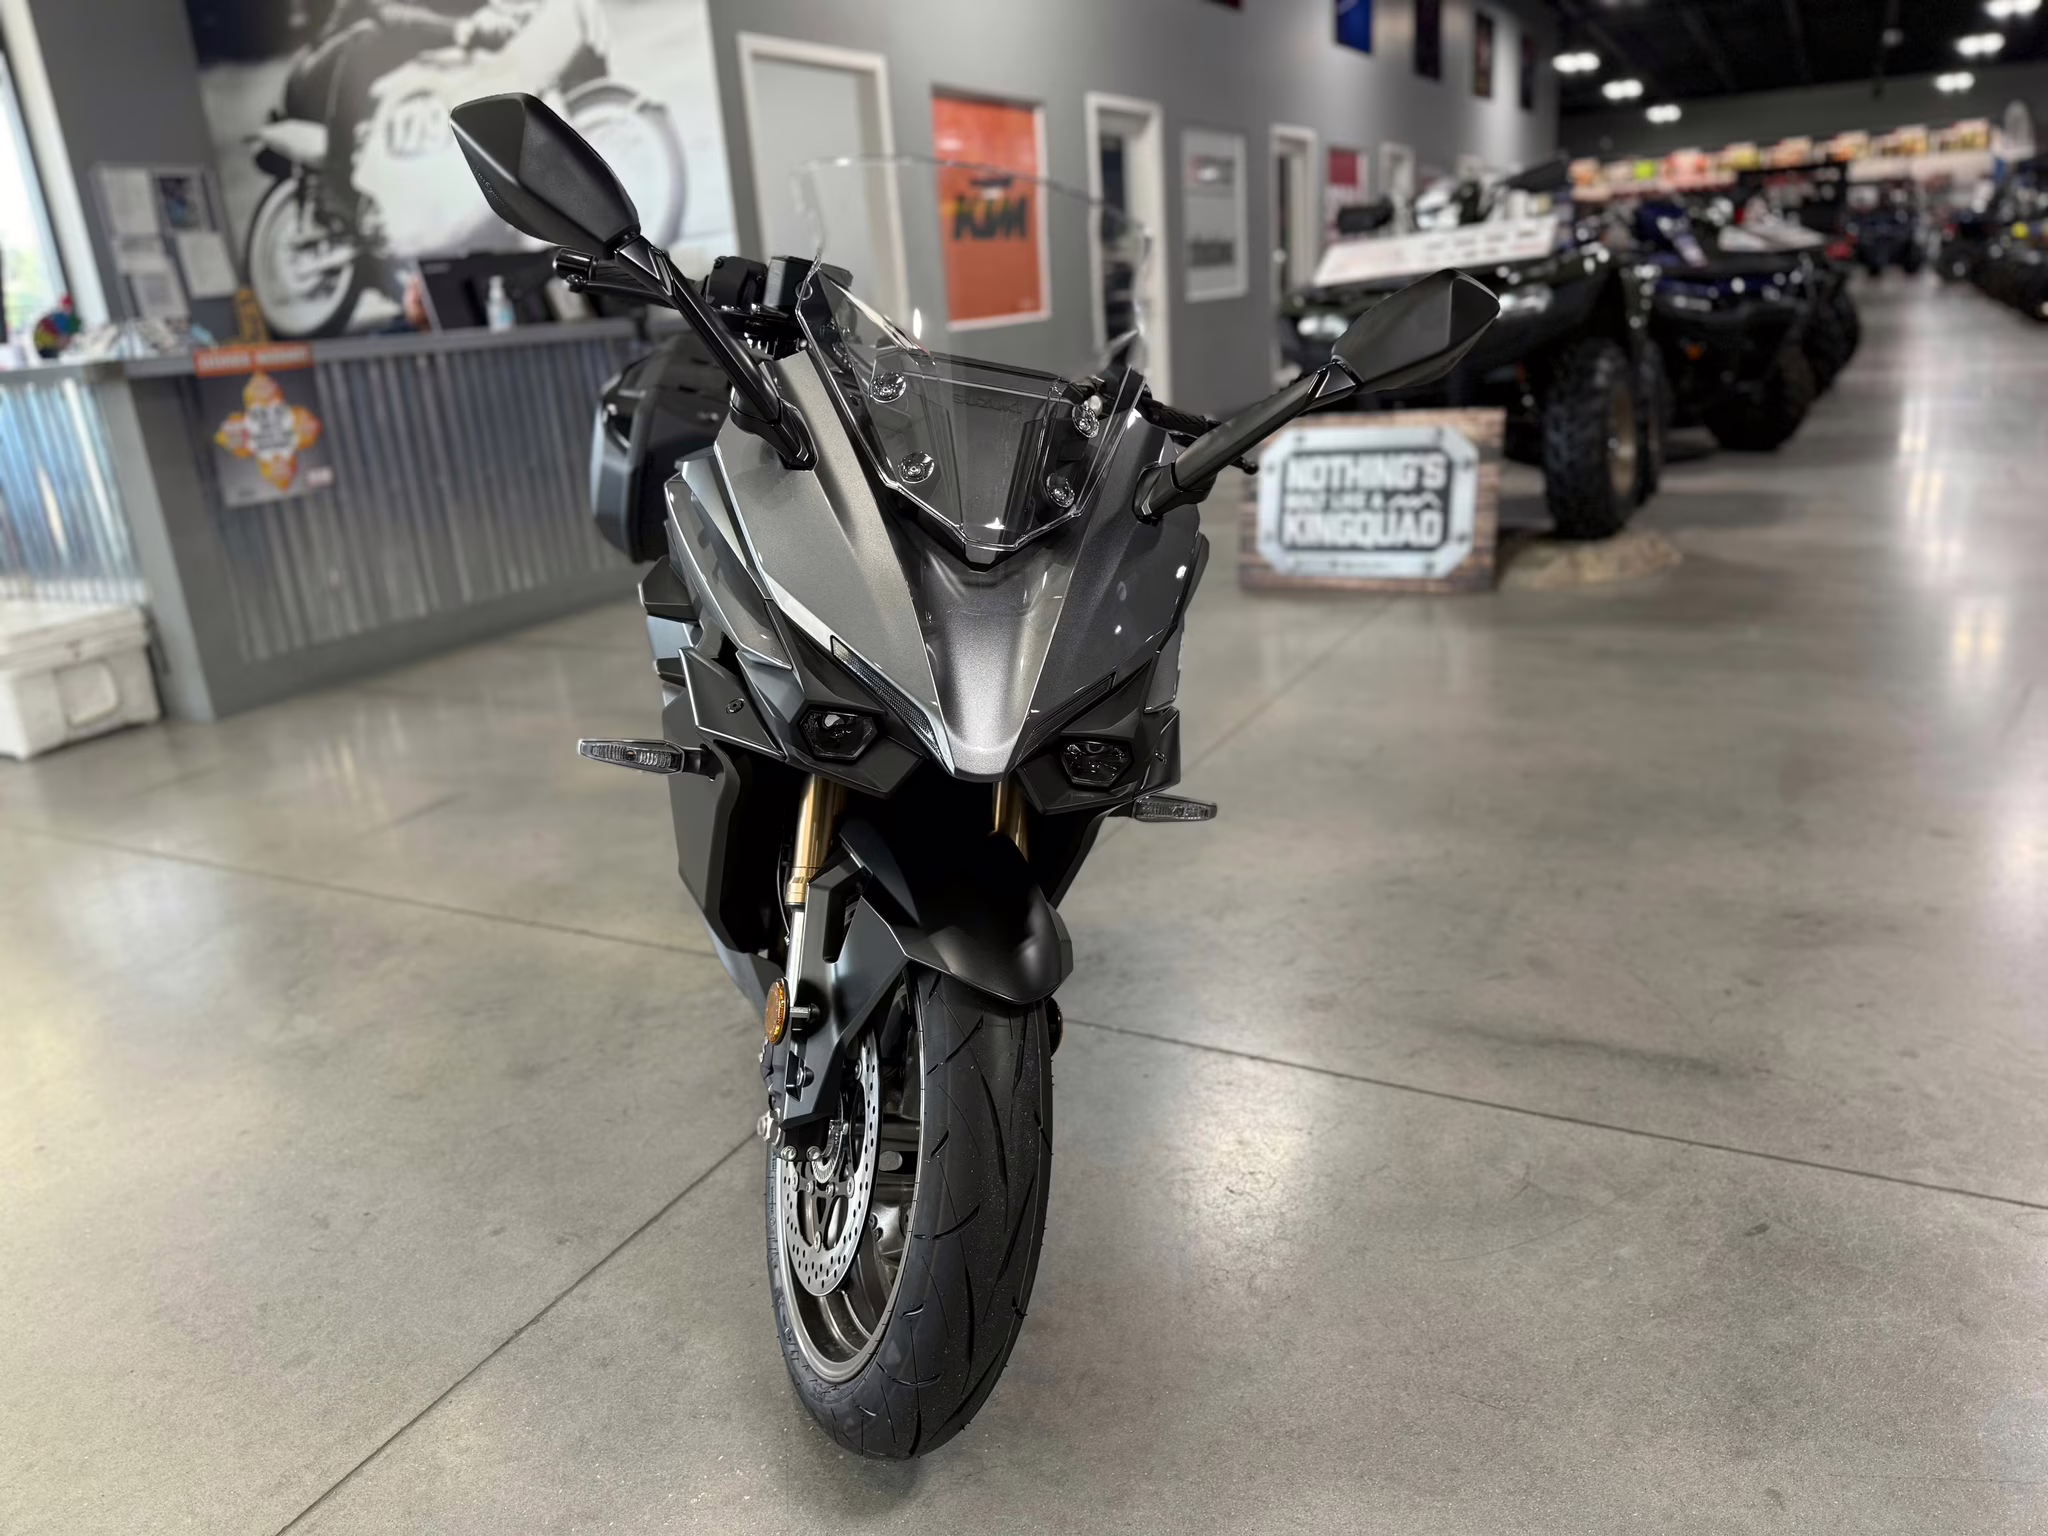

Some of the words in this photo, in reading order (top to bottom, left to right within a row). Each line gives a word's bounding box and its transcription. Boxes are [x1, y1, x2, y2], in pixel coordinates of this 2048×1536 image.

[953, 196, 1028, 241] KTM
[953, 392, 1023, 415] SUZUKI
[1286, 454, 1447, 489] NOTHING'S
[1283, 512, 1444, 547] KINGQUAD
